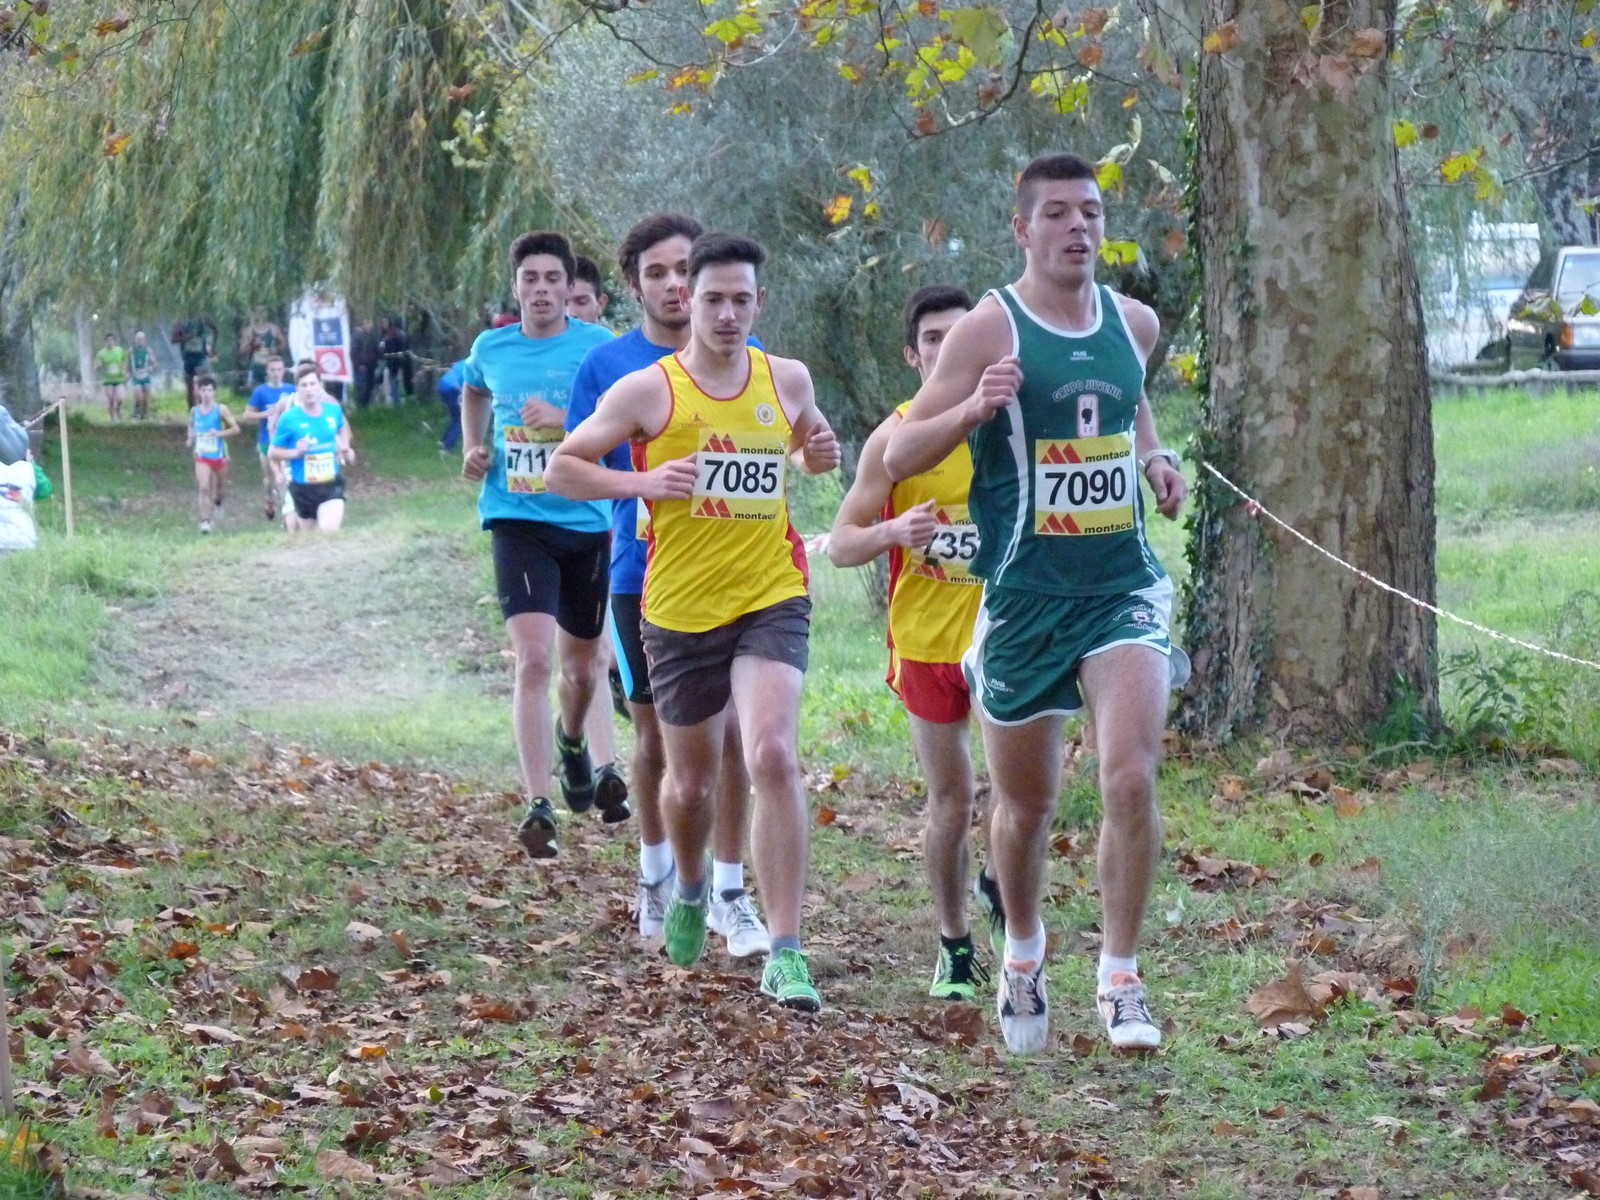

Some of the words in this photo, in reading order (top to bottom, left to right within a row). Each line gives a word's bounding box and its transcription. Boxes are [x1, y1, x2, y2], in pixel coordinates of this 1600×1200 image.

[1052, 380, 1084, 401] GRUPO
[1085, 379, 1123, 400] JUVENIL
[510, 448, 557, 473] 711
[740, 446, 785, 455] montaco
[1085, 450, 1130, 463] montaco
[704, 459, 778, 494] 7085
[1045, 466, 1126, 506] 7090
[1084, 522, 1132, 534] montaco
[924, 532, 979, 560] 735
